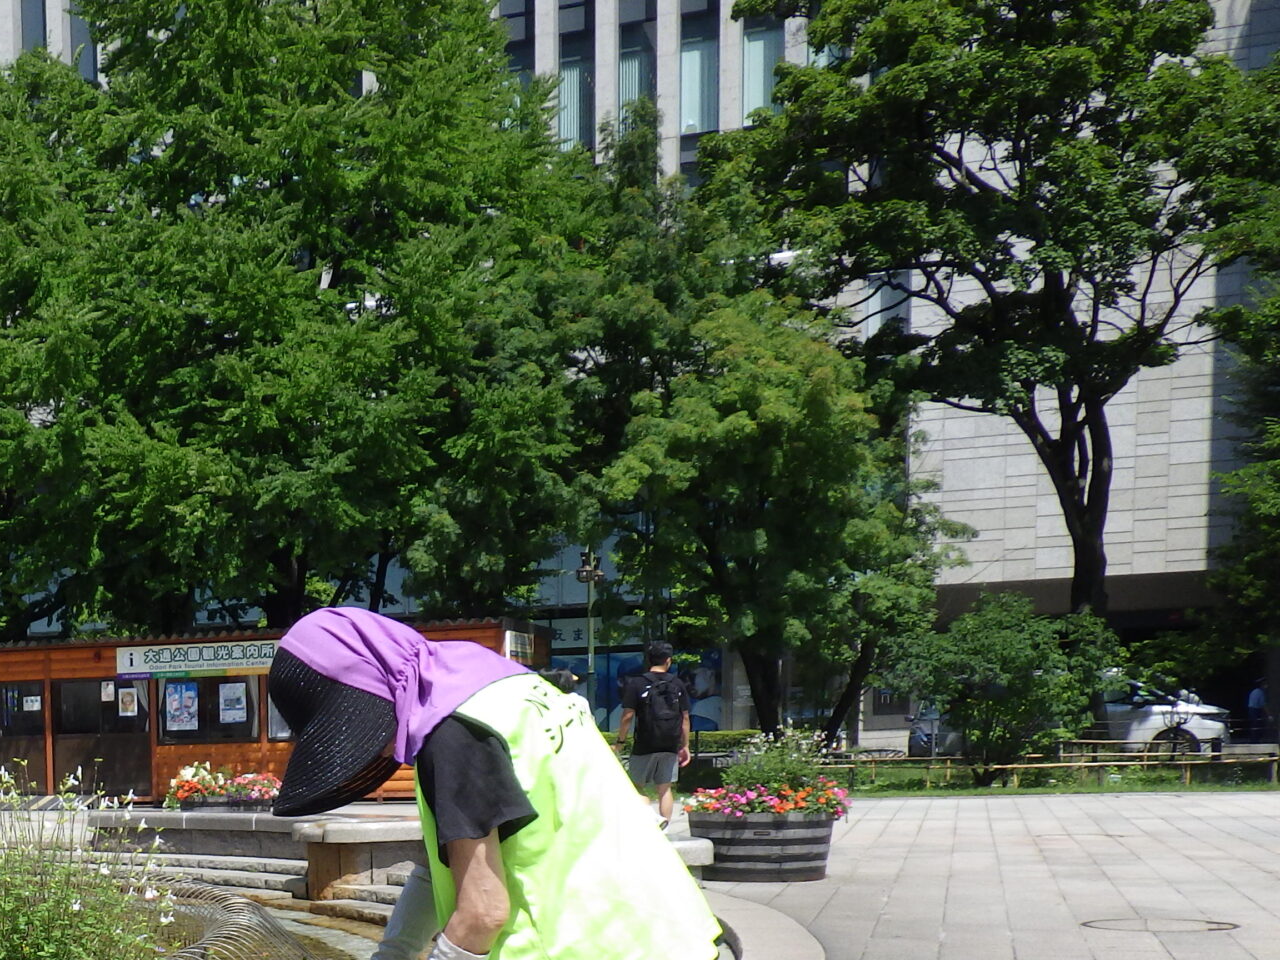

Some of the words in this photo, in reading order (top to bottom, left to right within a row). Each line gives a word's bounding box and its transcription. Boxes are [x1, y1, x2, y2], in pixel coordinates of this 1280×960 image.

[144, 643, 275, 664] 大通公園観光案内所
